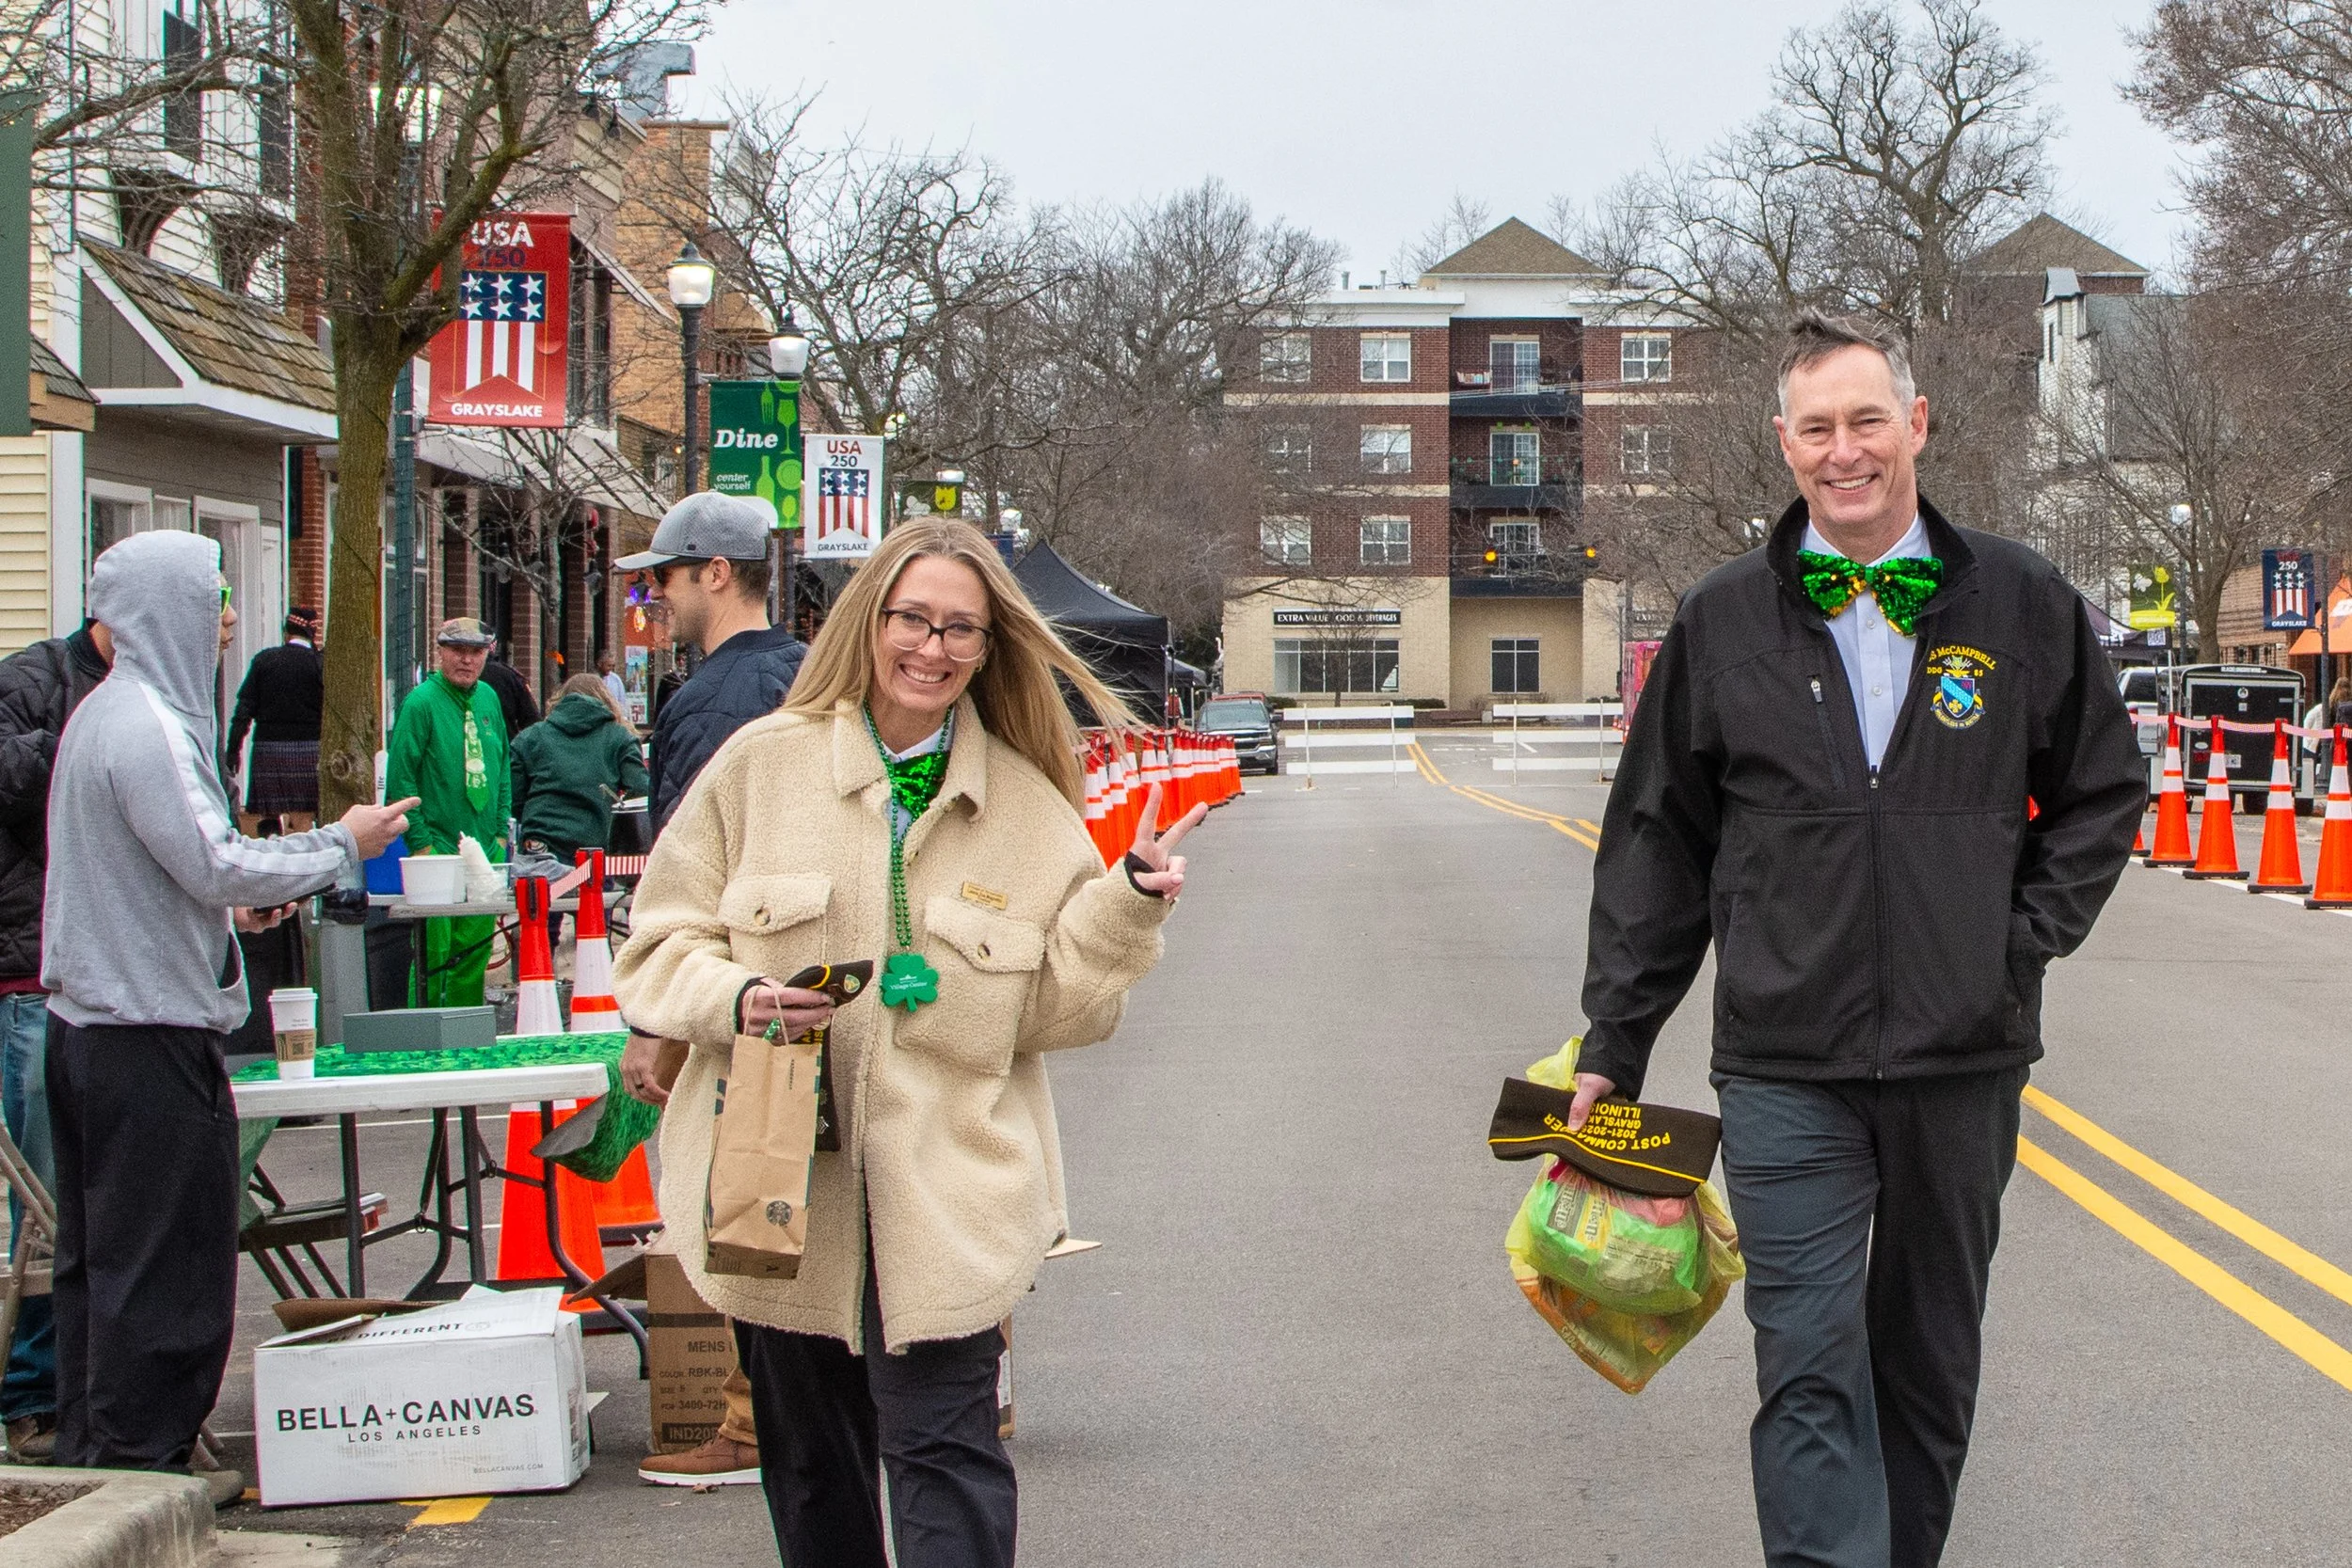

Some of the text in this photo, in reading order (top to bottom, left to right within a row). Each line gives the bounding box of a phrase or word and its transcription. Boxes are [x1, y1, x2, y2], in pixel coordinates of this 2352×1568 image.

[470, 221, 533, 247] USA
[451, 403, 543, 417] GRAYSLAKE
[714, 427, 778, 449] Dine
[827, 440, 862, 454] USA
[831, 455, 858, 467] 250
[716, 473, 749, 483] center
[714, 481, 751, 492] yourself
[818, 543, 868, 551] GRAYSLAKE
[2279, 562, 2297, 571] 250
[1936, 645, 1996, 671] McCAMPBELL
[1587, 1116, 1642, 1130] GRAYSLAK
[1630, 1132, 1672, 1150] POST
[358, 1323, 465, 1339] DIFFERENT
[688, 1340, 725, 1353] MENS
[278, 1394, 535, 1431] BELLA+CANVAS
[348, 1425, 482, 1443] LOS ANGELES
